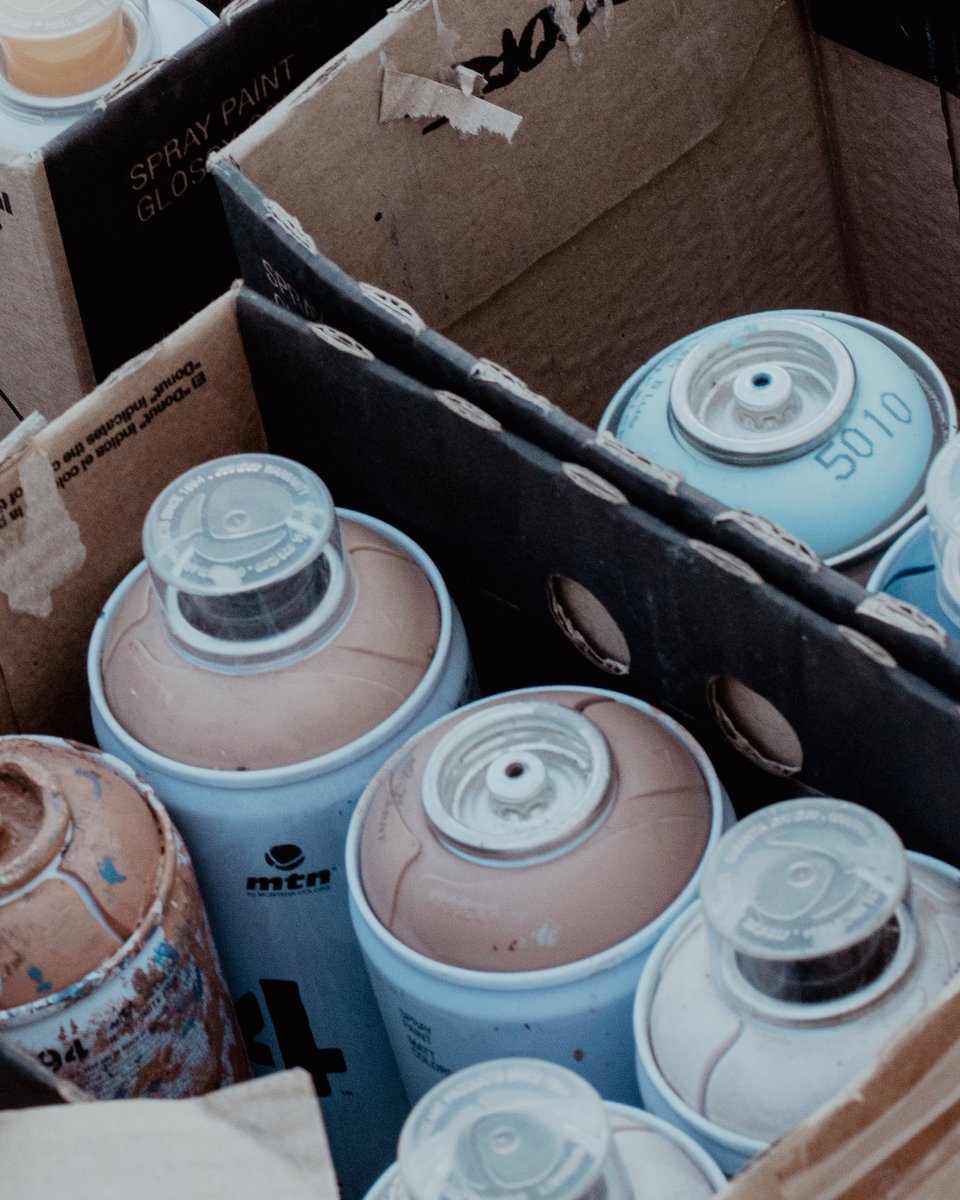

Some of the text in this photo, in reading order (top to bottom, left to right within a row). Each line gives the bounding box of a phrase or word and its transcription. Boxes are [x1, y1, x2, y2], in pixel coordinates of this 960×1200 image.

[128, 107, 223, 192] SPRAY
[220, 54, 297, 130] PAINT
[191, 370, 207, 390] El
[86, 395, 149, 444] indicates
[95, 424, 138, 460] indica
[813, 388, 915, 484] 5010
[62, 441, 85, 463] the
[82, 454, 95, 473] el
[8, 486, 24, 505] of
[8, 505, 25, 522] la
[246, 869, 331, 891] mtn
